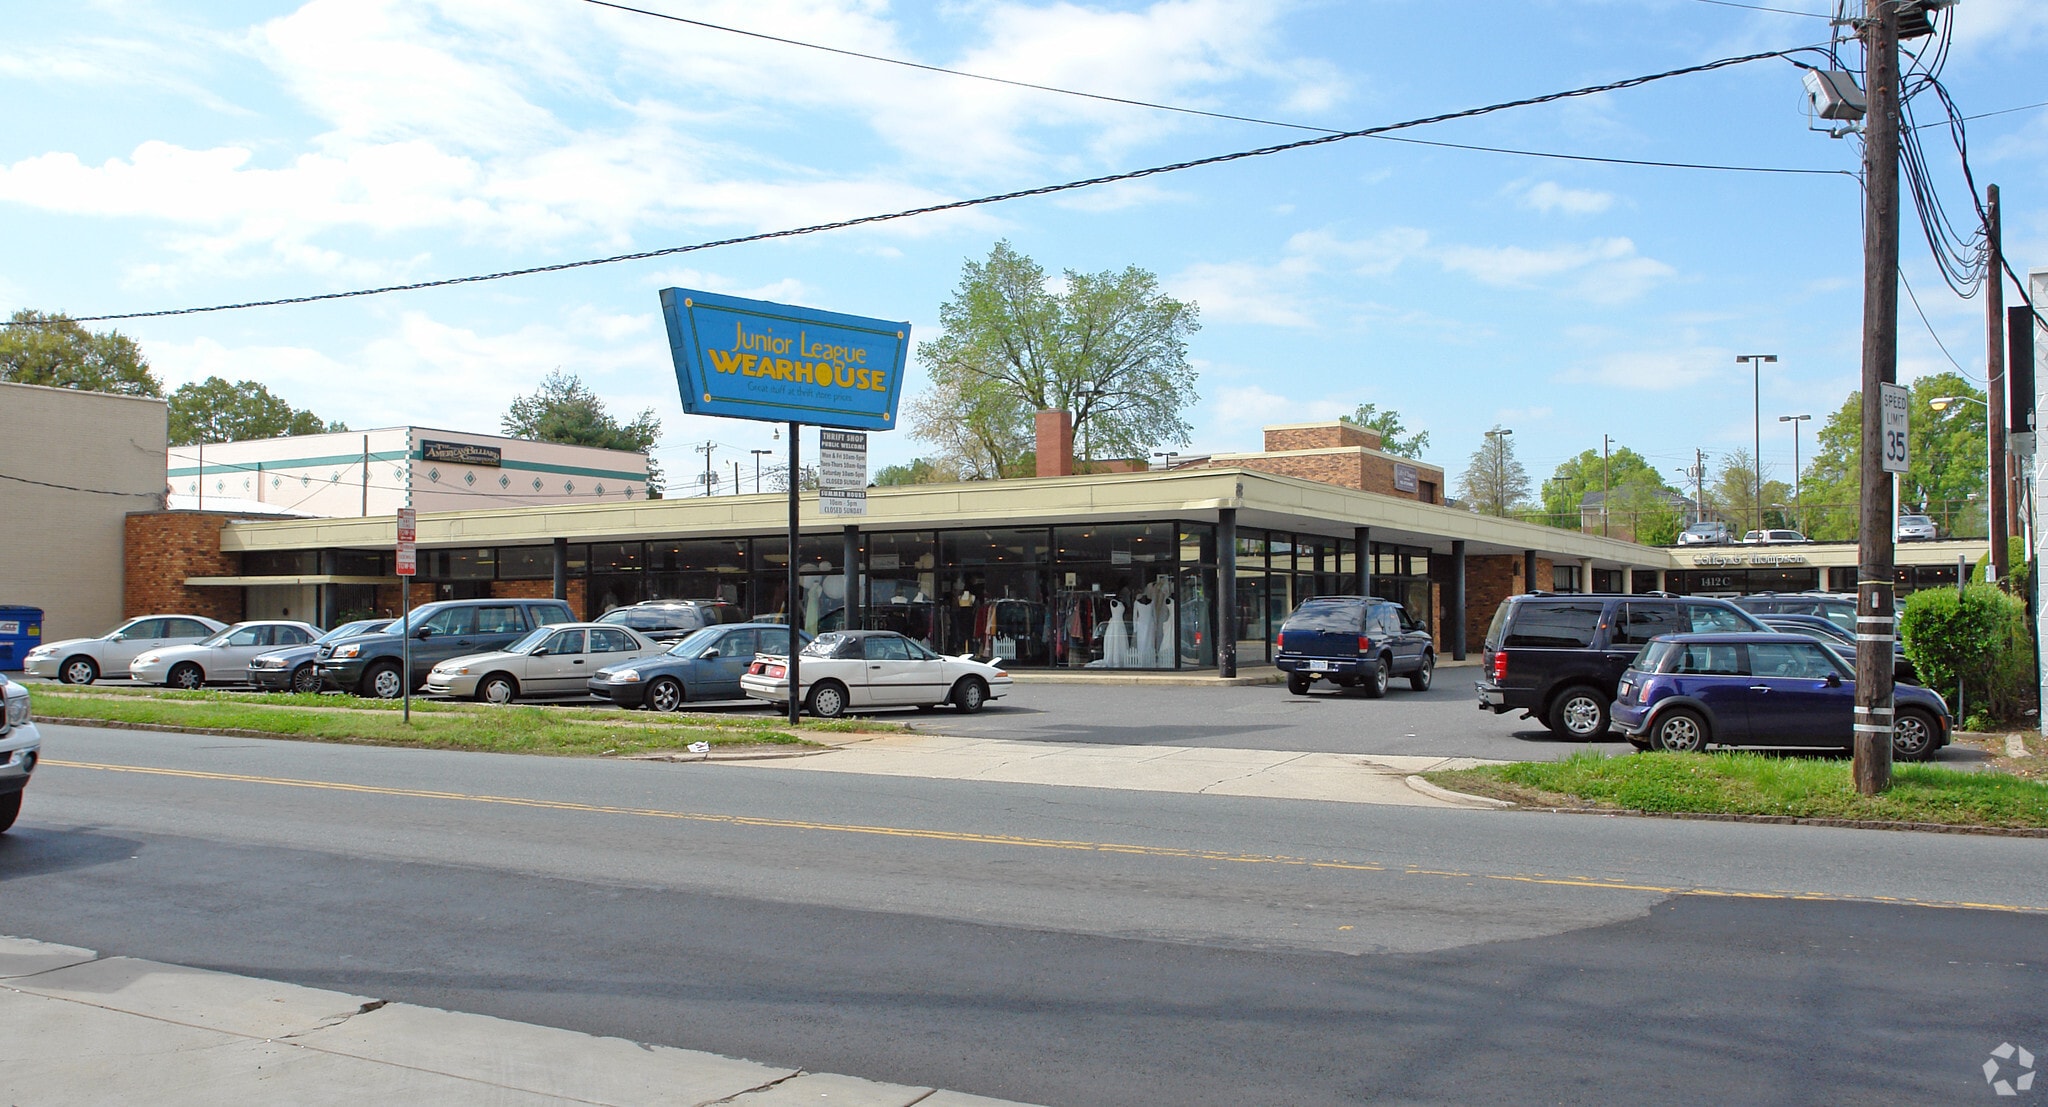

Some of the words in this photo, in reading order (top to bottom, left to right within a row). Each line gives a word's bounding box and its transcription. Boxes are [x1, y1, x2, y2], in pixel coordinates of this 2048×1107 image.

[731, 321, 793, 355] Junior
[800, 331, 867, 370] League
[708, 349, 887, 392] WEARHOUSE
[747, 381, 768, 393] Great
[770, 384, 786, 395] stuff
[788, 387, 795, 396] at
[797, 386, 814, 398] thrift
[815, 390, 832, 400] store
[833, 393, 853, 403] prices
[1884, 394, 1906, 410] SPEED
[1886, 412, 1904, 425] LIMIT
[822, 432, 845, 441] THRIFT
[1886, 430, 1906, 462] 35
[1701, 577, 1721, 586] 1412
[1722, 577, 1730, 586] C
